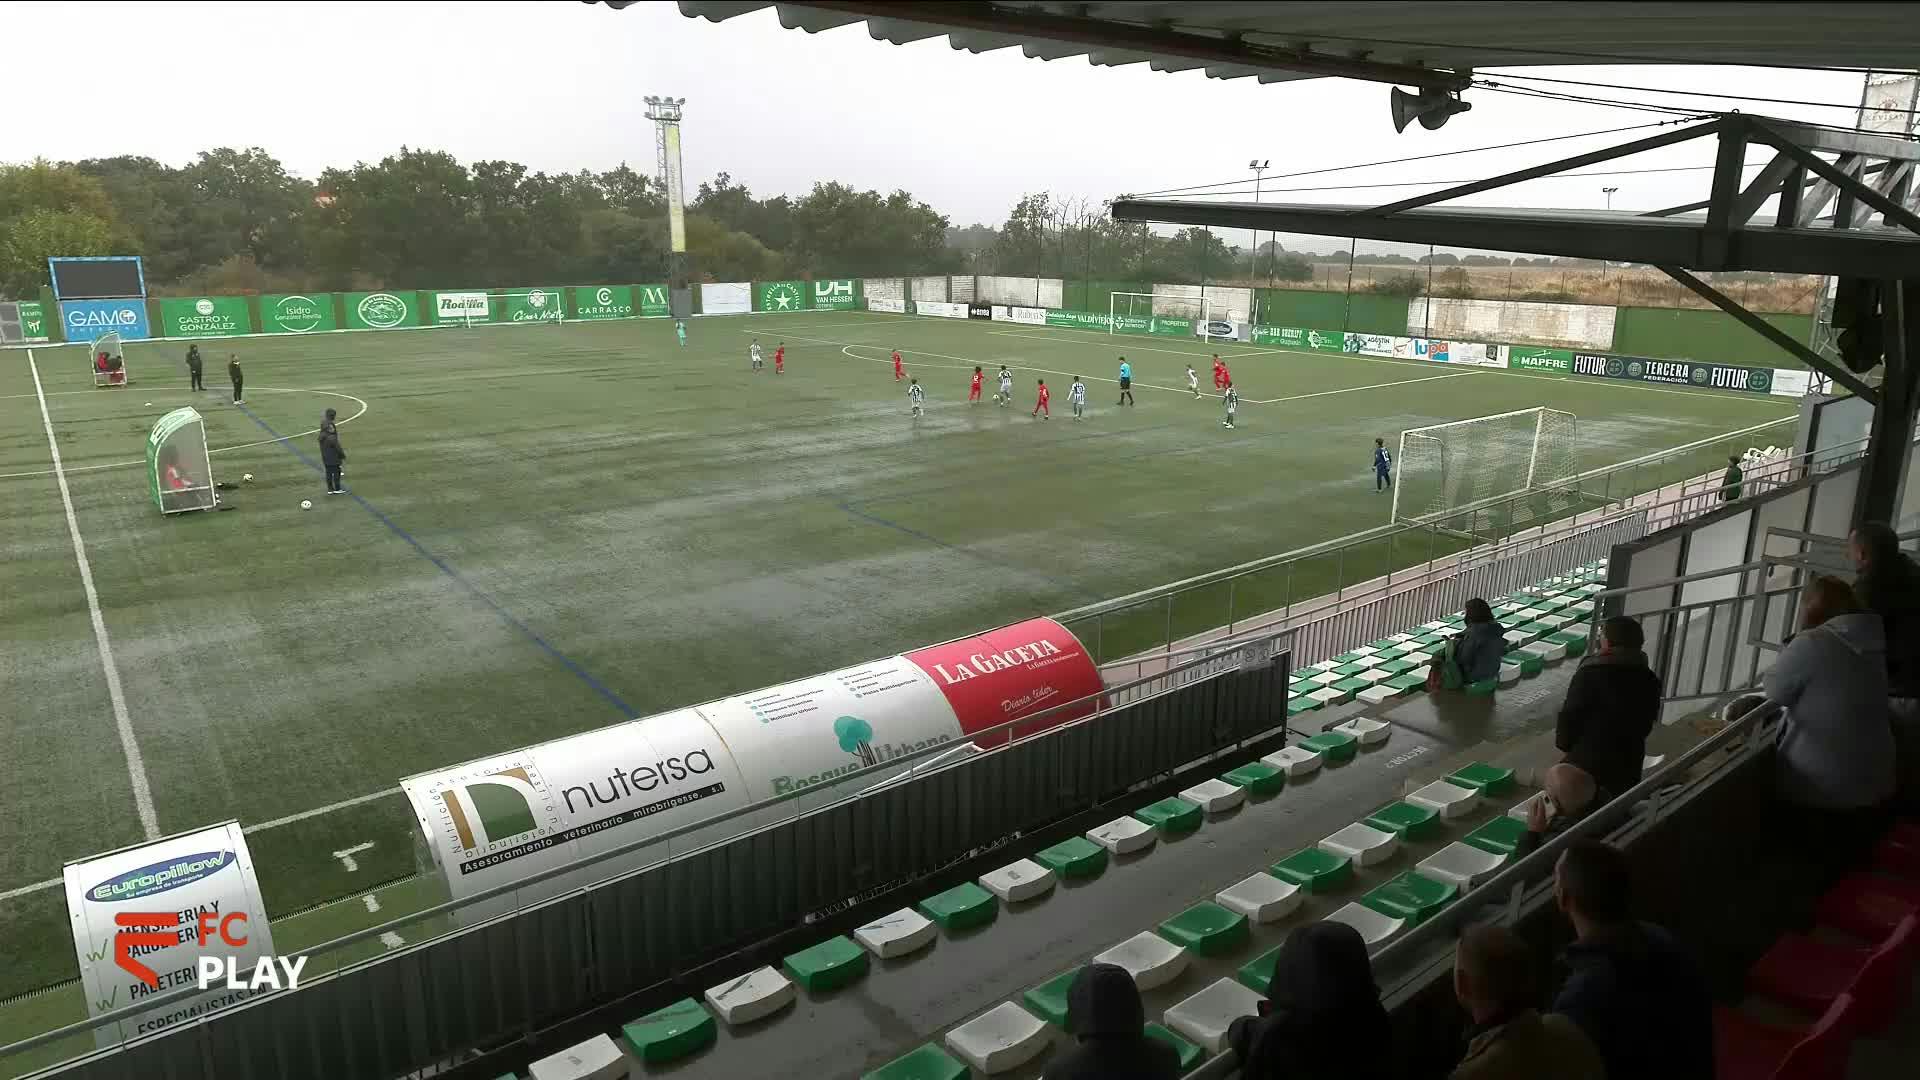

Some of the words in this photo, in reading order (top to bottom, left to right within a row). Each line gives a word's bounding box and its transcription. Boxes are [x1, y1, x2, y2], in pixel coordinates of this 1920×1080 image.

[441, 298, 484, 310] Rodilla
[642, 287, 667, 305] M
[816, 296, 829, 304] VAN
[829, 295, 853, 303] HESSEN
[286, 306, 311, 315] Isidro
[578, 305, 632, 314] CARRASCO
[178, 315, 220, 324] CASTRO
[1415, 339, 1448, 360] lupa
[1521, 356, 1568, 369] MAPFRE
[1645, 361, 1689, 378] TERCERA
[1643, 375, 1688, 384] FEDERACIÓN
[970, 639, 1062, 675] GACETA
[1002, 695, 1032, 712] Diario
[561, 748, 716, 814] nutersa
[464, 838, 553, 873] Asesoramiento
[563, 815, 623, 840] veterinario
[94, 848, 226, 898] Europillow
[136, 886, 163, 897] empresa
[172, 872, 204, 886] transporte
[130, 965, 198, 1000] PALETERI
